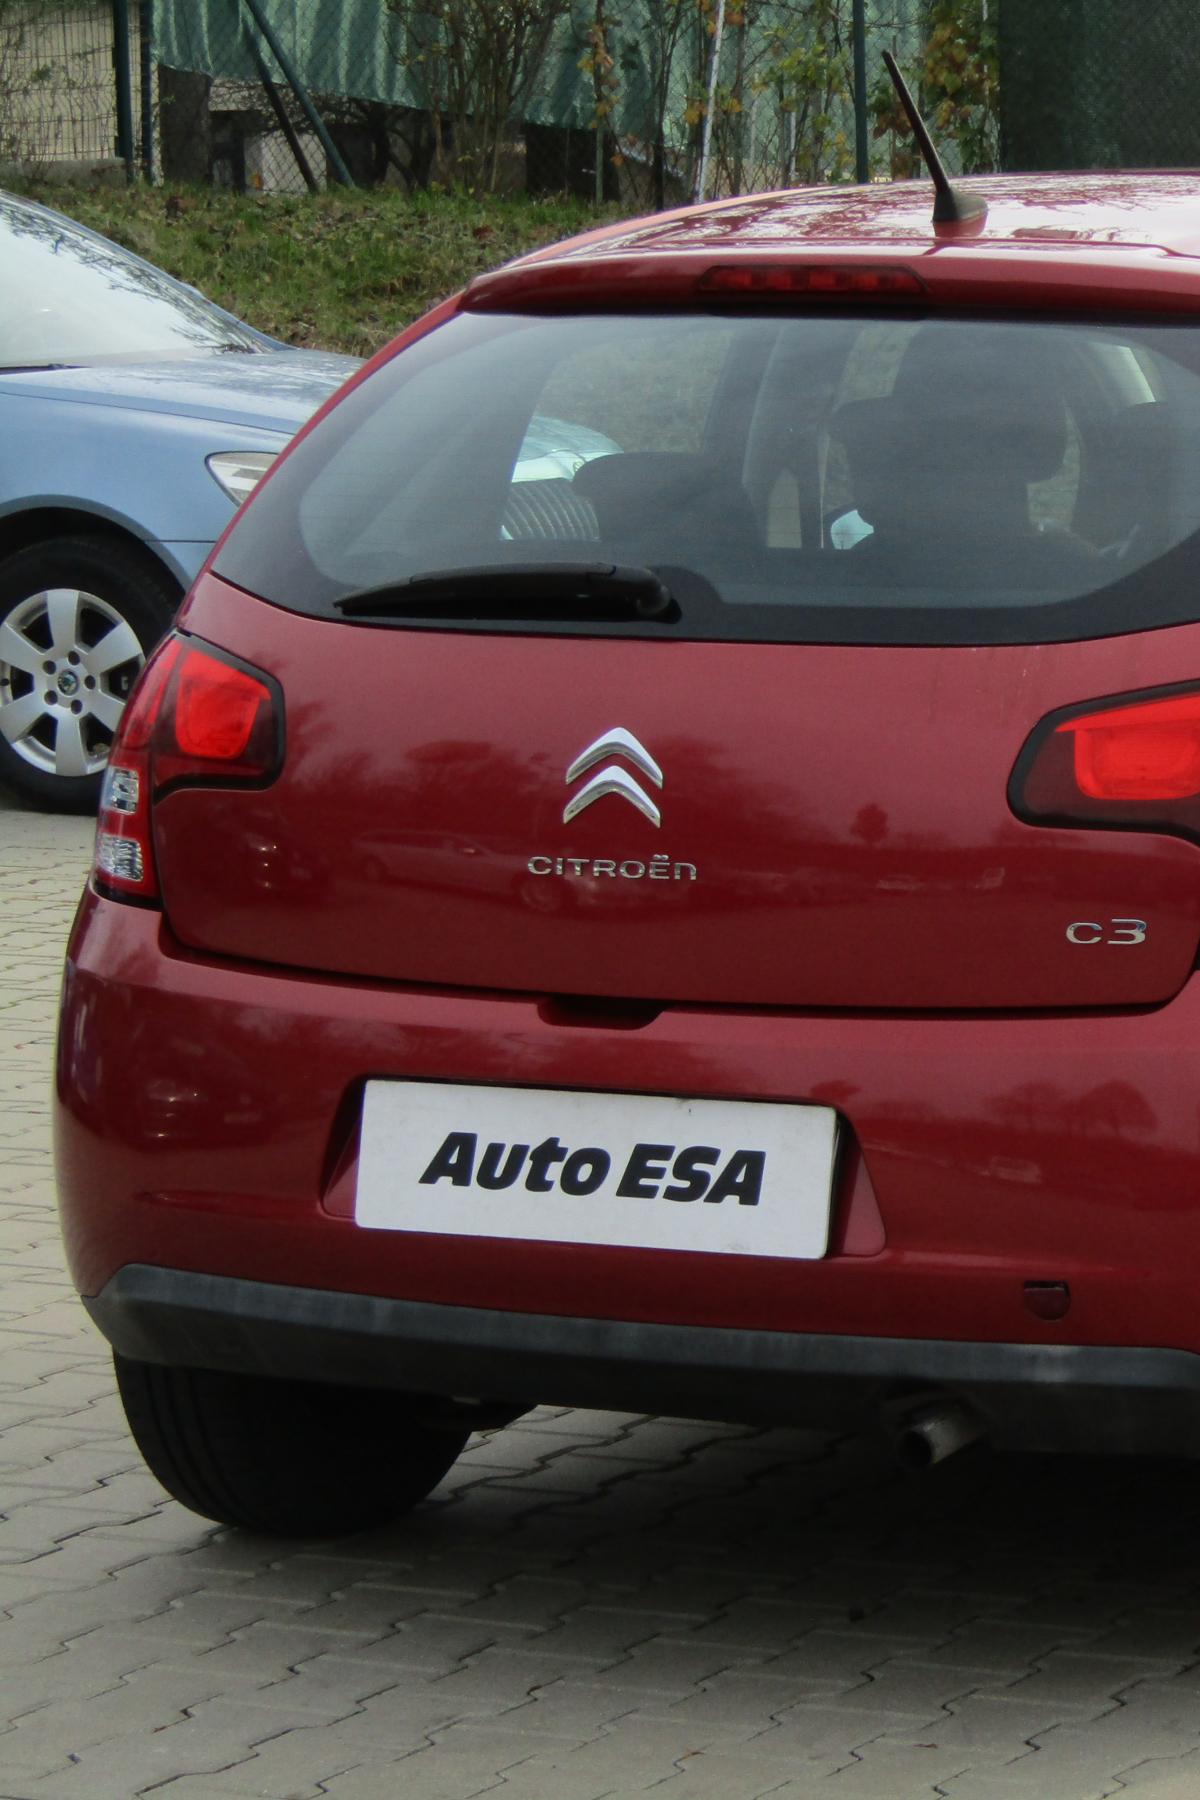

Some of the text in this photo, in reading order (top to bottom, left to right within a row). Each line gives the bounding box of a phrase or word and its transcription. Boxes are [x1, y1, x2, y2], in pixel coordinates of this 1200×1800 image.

[1066, 918, 1147, 944] C3
[418, 1131, 767, 1206] Auto ESA
